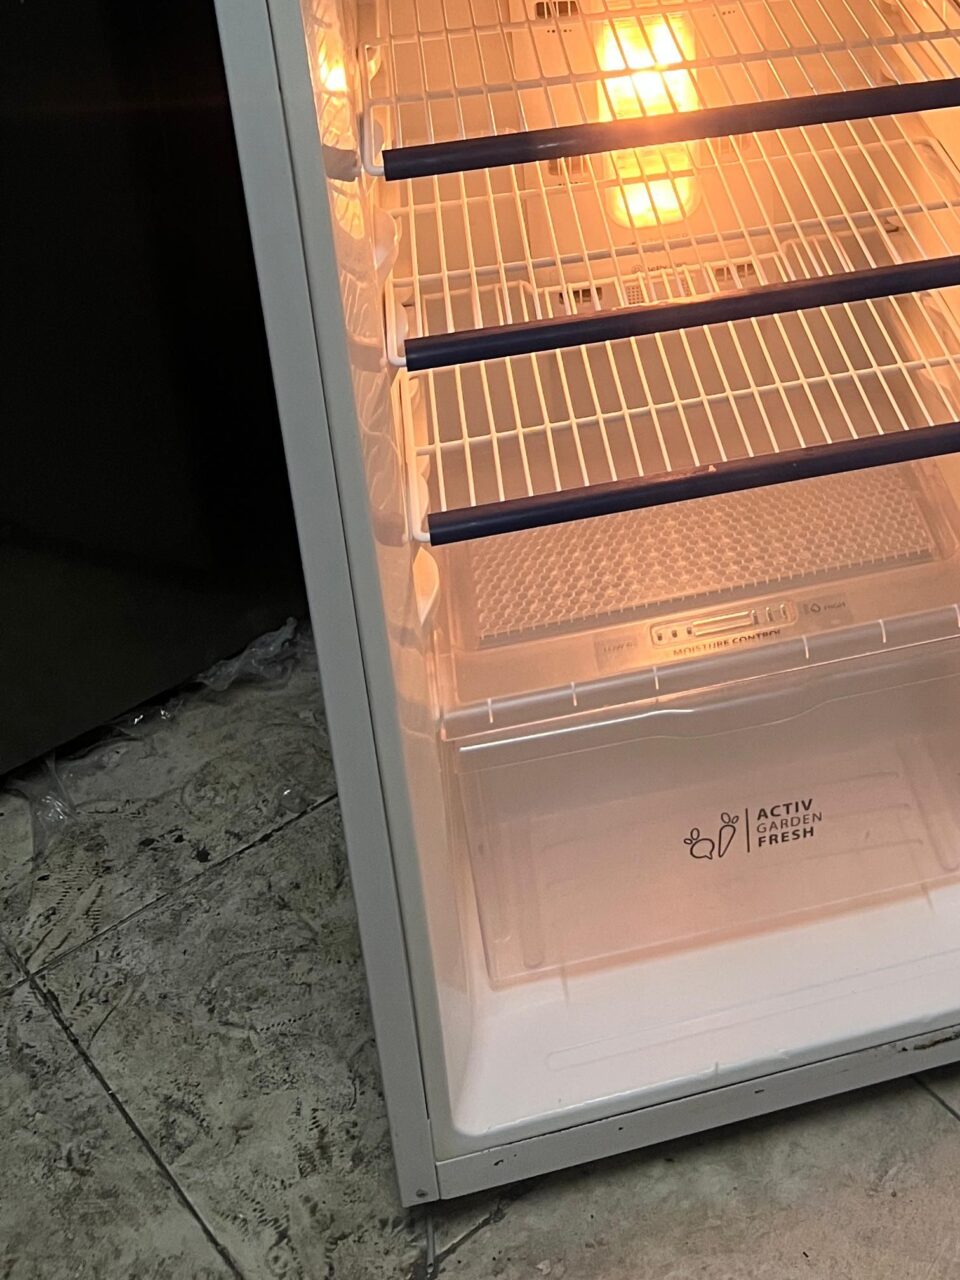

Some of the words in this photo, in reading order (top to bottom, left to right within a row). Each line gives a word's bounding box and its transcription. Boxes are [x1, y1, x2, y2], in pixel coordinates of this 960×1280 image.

[757, 798, 813, 821] ACTIV
[756, 812, 823, 834] GARDEN
[758, 826, 814, 847] FRESH
